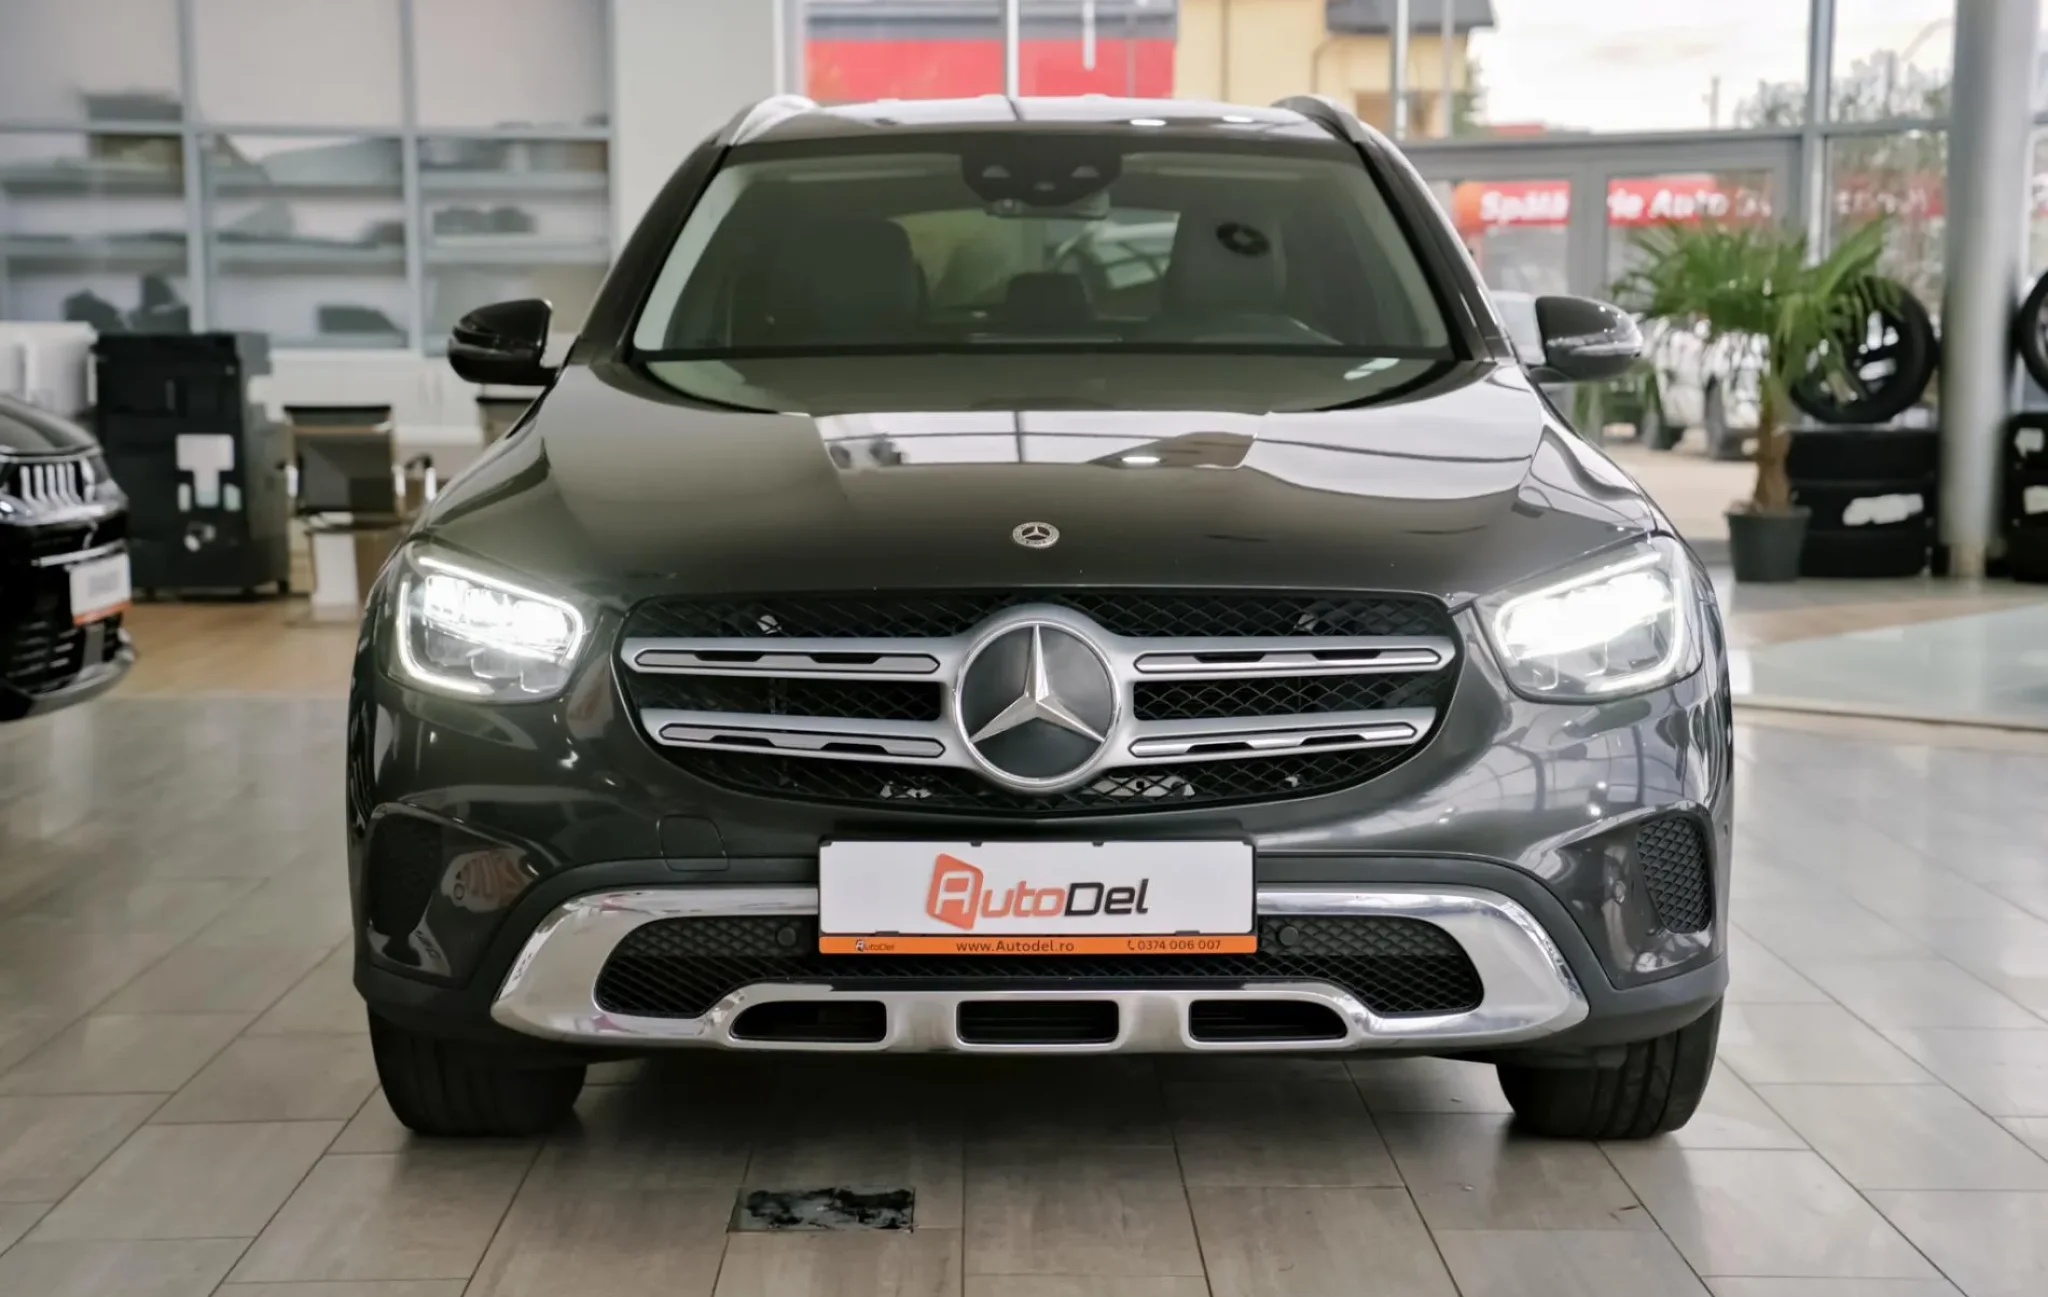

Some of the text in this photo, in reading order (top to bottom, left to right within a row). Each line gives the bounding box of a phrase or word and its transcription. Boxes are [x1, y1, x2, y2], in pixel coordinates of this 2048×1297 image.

[925, 853, 1149, 930] AutoDel
[956, 940, 1075, 952] www.Autodel.ro
[1137, 940, 1221, 951] 0374 006 007
